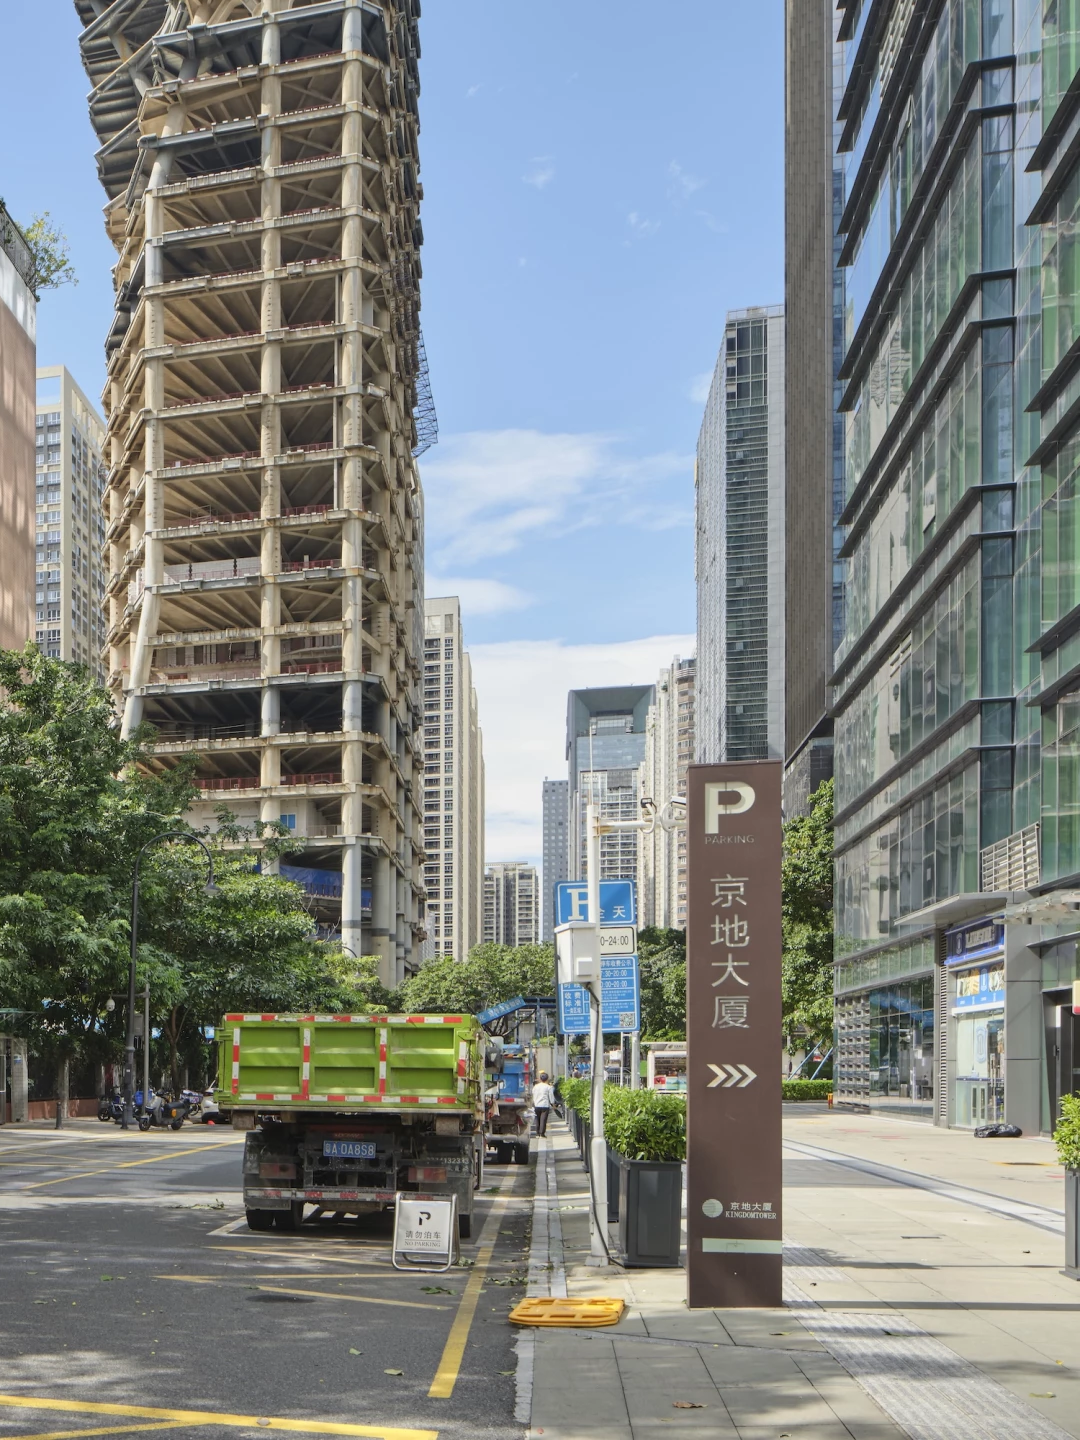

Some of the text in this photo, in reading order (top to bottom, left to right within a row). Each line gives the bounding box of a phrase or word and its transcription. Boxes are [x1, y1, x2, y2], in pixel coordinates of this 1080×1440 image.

[705, 781, 756, 835] P
[704, 834, 755, 845] PARKING
[710, 874, 750, 1029] 京地大厦
[730, 1201, 773, 1212] 京地大厦
[725, 1211, 777, 1220] KINGDOMTOWER
[405, 1230, 442, 1240] 请勿泊车
